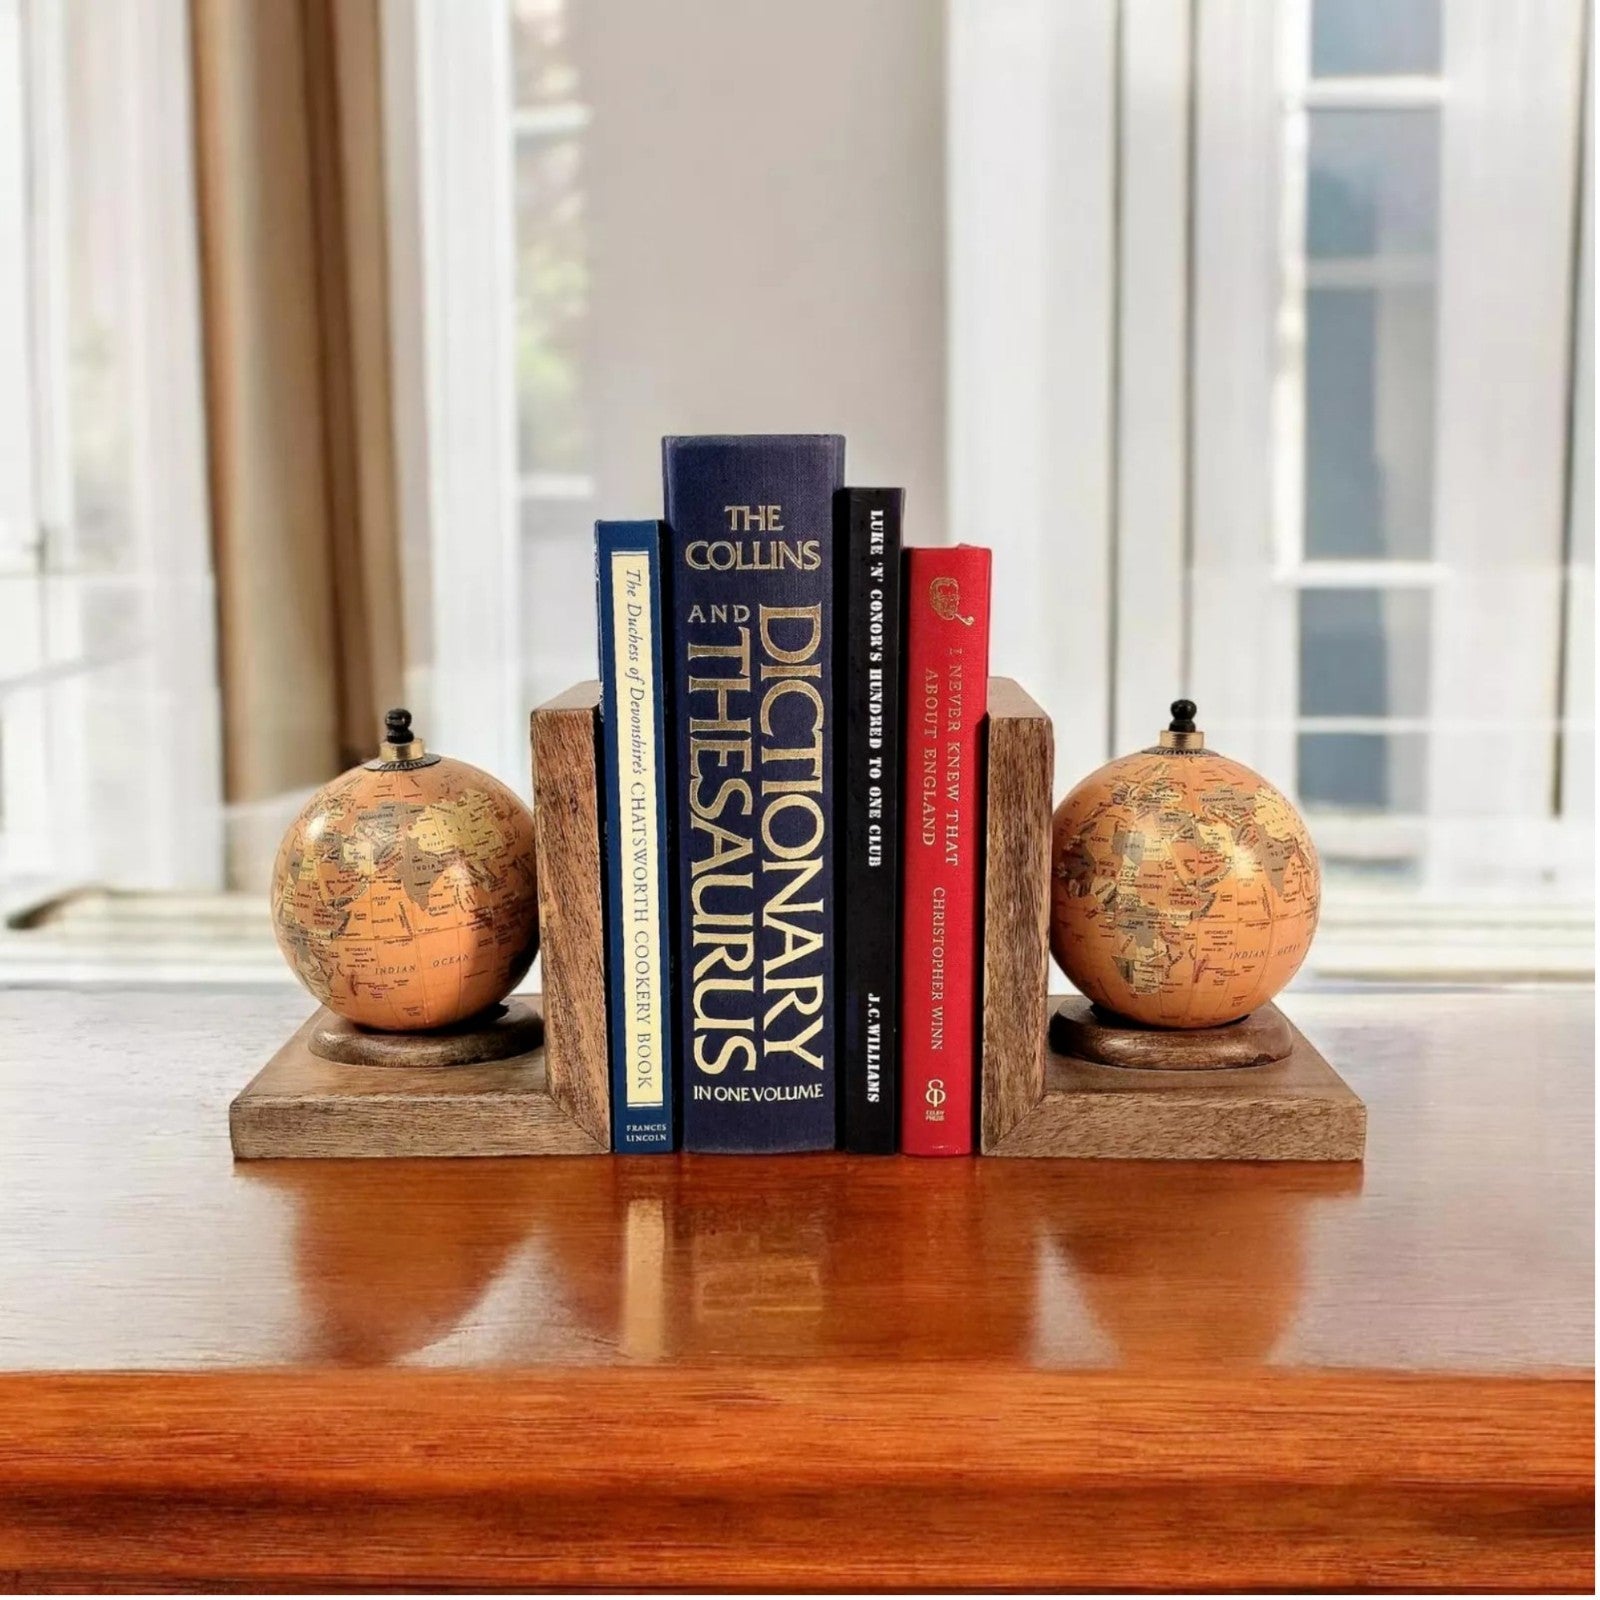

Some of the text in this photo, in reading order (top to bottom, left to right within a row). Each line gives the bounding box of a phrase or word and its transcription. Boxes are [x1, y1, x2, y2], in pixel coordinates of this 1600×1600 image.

[724, 504, 785, 531] THE
[685, 540, 822, 571] COLLINS
[687, 604, 751, 624] AND
[868, 509, 884, 867] LUKE 'N' CONOR'S HUNDRED TO ONE CLUB
[922, 668, 939, 846] ABOUT ENGLAND
[945, 647, 962, 866] I NEVER KNEW THAT
[625, 569, 652, 1089] The Duchess of Devonshire's CHATSWORTH COOKERY BOOK
[759, 602, 825, 1071] DICTIONARY
[687, 626, 757, 1075] THESAURUS
[375, 954, 470, 975] INDIAN OCEAN
[931, 886, 945, 1051] CHRISTOPHER WINN
[1228, 950, 1265, 960] INDIAN
[693, 1083, 824, 1102] IN ONE VOLUME
[626, 1123, 667, 1132] FRANCES
[626, 1133, 667, 1142] LINCOLN
